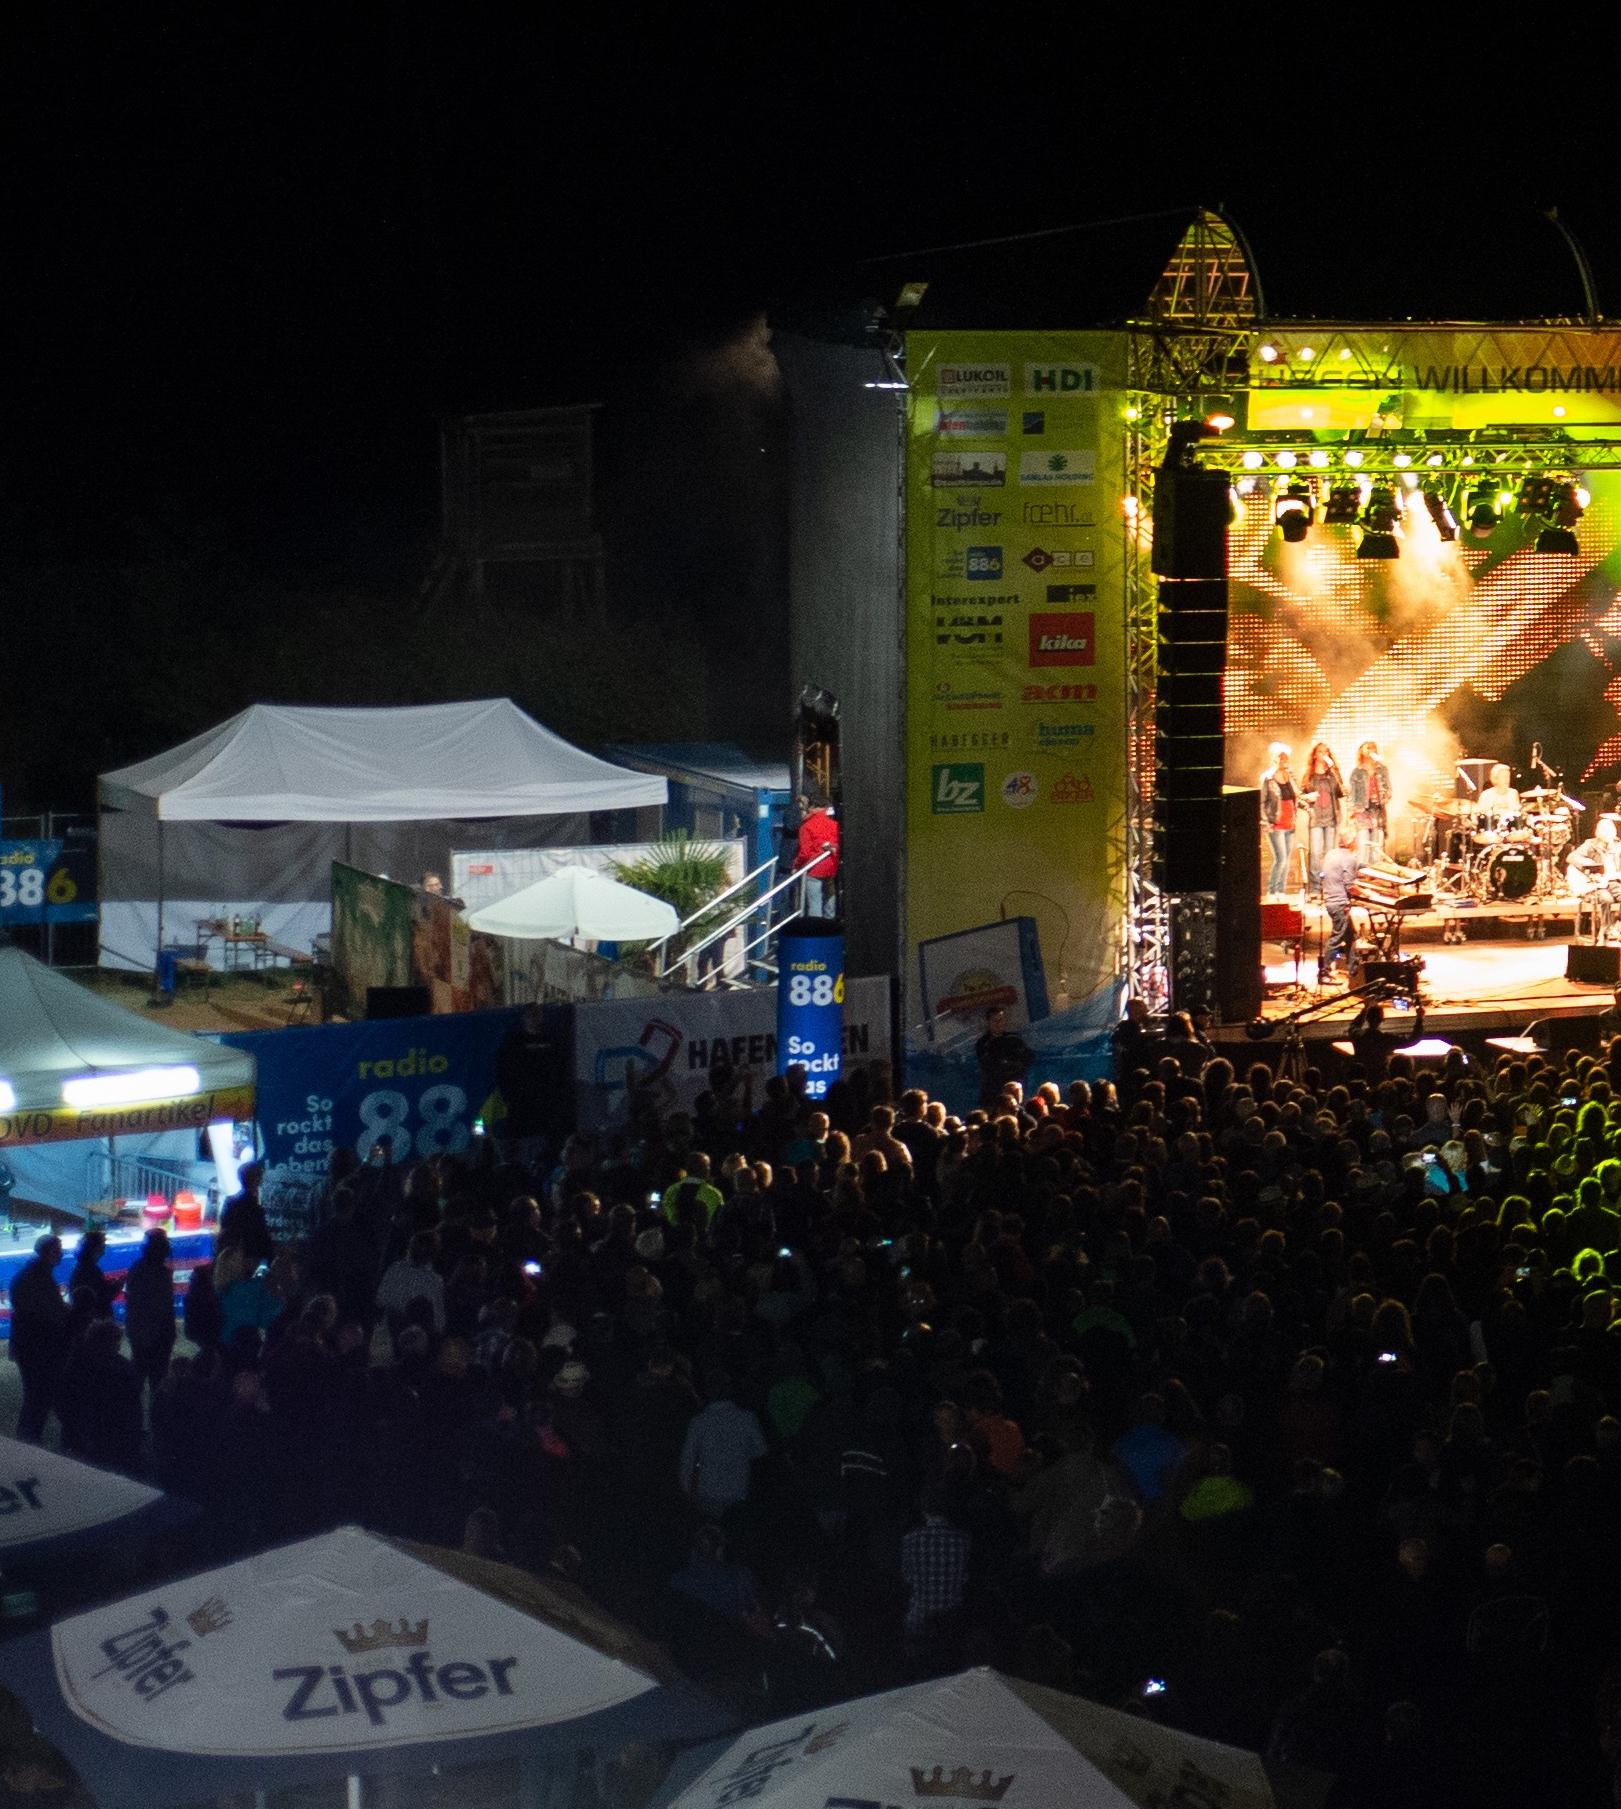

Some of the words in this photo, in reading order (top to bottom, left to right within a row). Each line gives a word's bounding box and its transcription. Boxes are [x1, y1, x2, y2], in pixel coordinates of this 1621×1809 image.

[956, 369, 1008, 383] LUKOIL
[1033, 368, 1092, 391] HDI
[936, 507, 1002, 532] Zipfer
[968, 557, 1000, 571] 886
[1040, 635, 1087, 650] kika
[937, 768, 980, 805] bz
[0, 850, 35, 865] adio
[790, 959, 827, 972] radio
[788, 1035, 815, 1055] So
[356, 1047, 450, 1081] radio
[804, 1079, 828, 1095] as
[76, 1094, 216, 1132] Fanartikel
[306, 1094, 334, 1114] So
[276, 1114, 334, 1135] rockt
[294, 1136, 335, 1155] das
[91, 1607, 196, 1702] Zipfer
[272, 1650, 519, 1726] Zipfer
